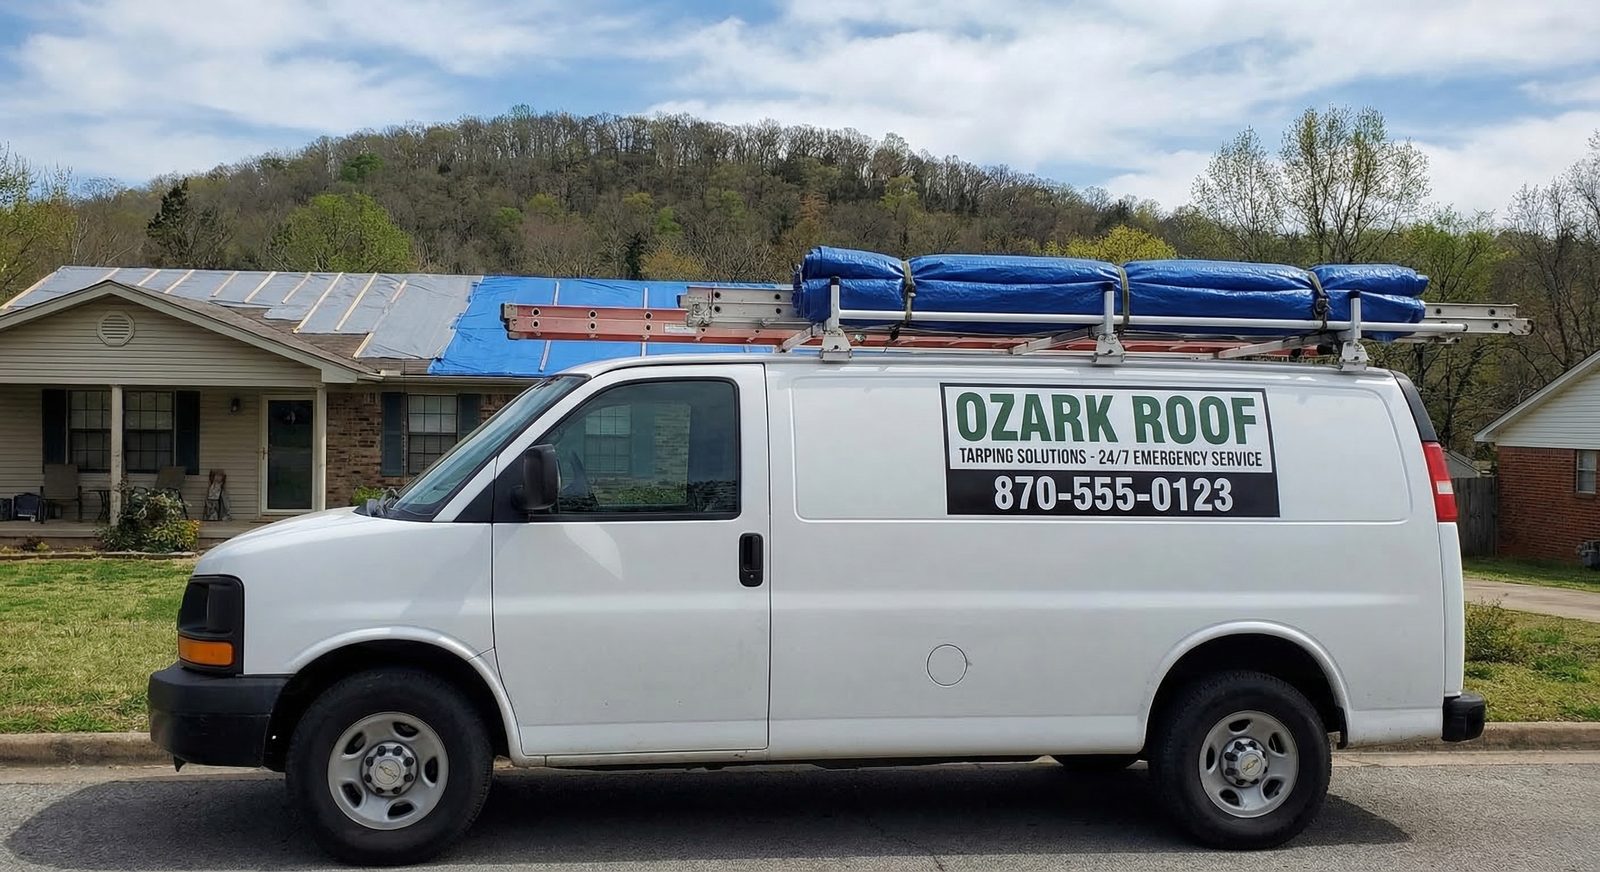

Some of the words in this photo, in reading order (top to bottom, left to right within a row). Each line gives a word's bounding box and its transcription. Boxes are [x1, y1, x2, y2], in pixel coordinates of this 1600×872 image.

[956, 392, 1118, 442] OZARK
[1132, 396, 1257, 445] ROOF
[959, 447, 1014, 464] TARPING
[1017, 448, 1087, 465] SOLUTIONS
[1098, 449, 1130, 465] 24/7
[1134, 449, 1208, 466] EMERGENCY
[1211, 451, 1263, 467] SERVICE
[994, 475, 1234, 512] 870-555-0123
